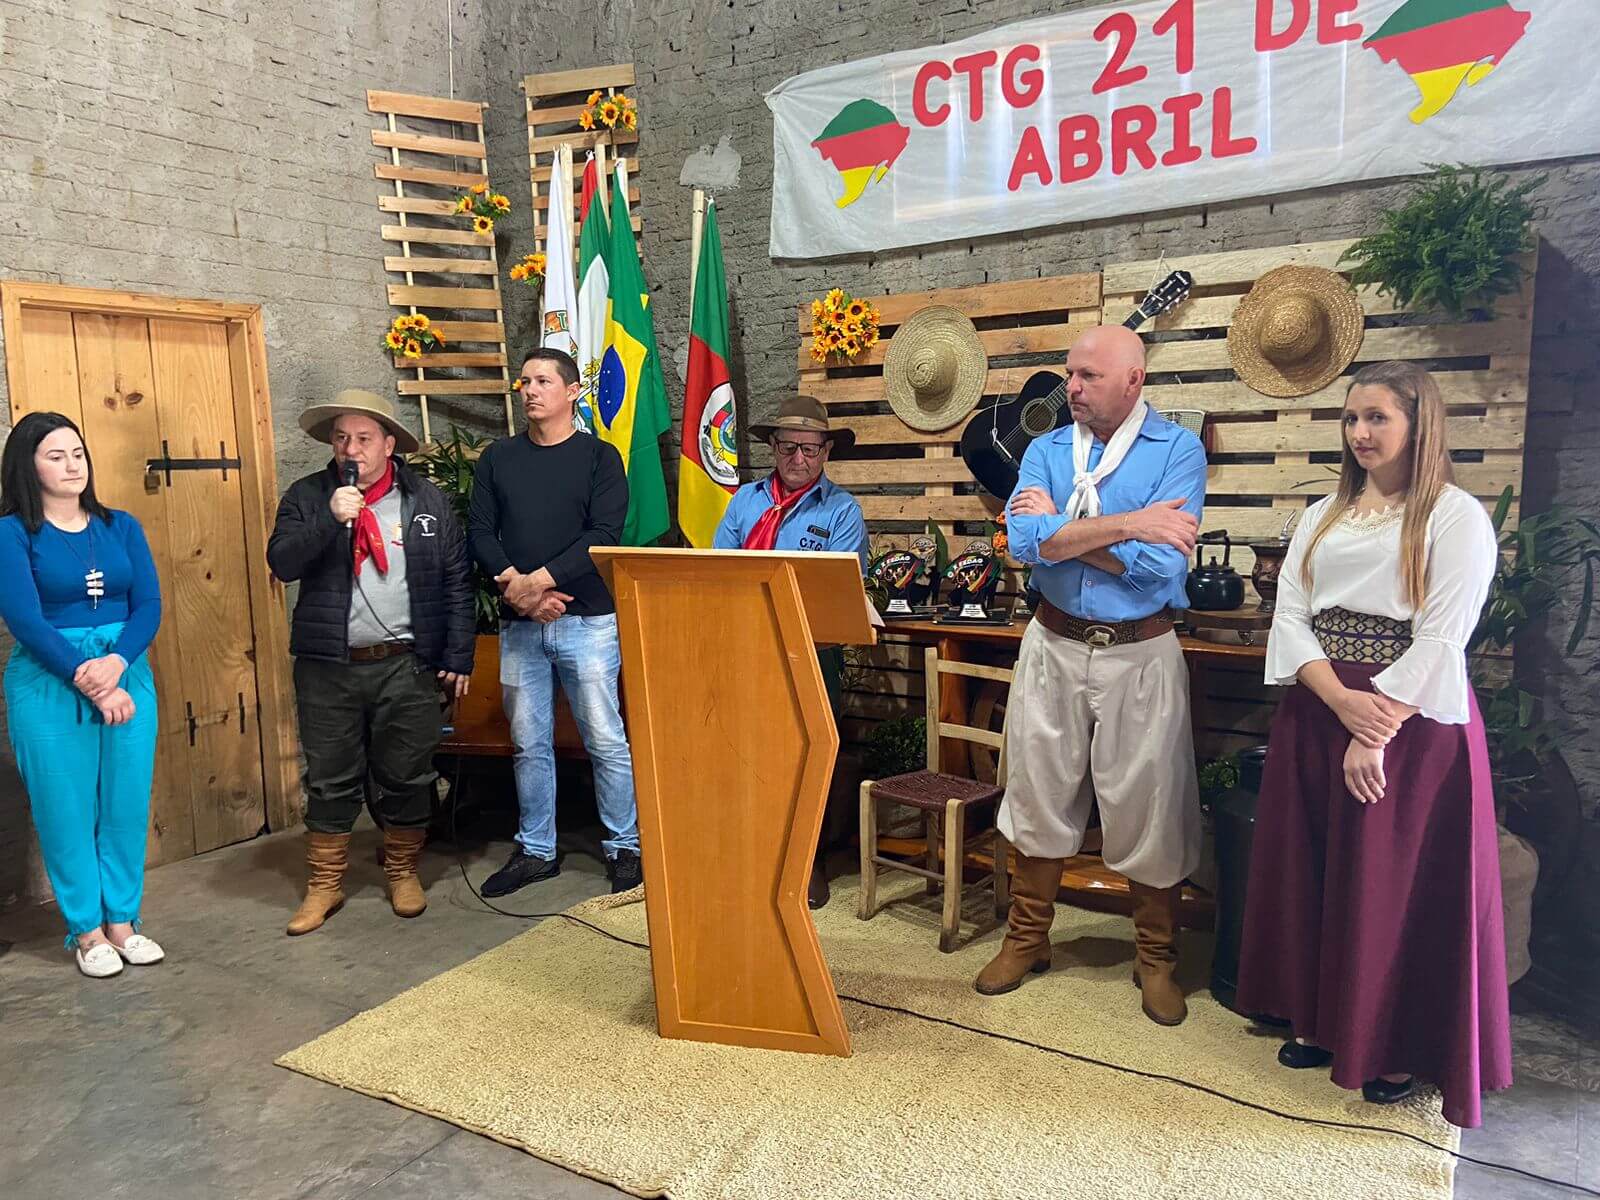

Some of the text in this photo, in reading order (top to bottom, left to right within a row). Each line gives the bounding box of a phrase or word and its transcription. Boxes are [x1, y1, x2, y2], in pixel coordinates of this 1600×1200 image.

[912, 0, 1363, 127] CTG 21 DE
[1007, 86, 1259, 192] ABRIL
